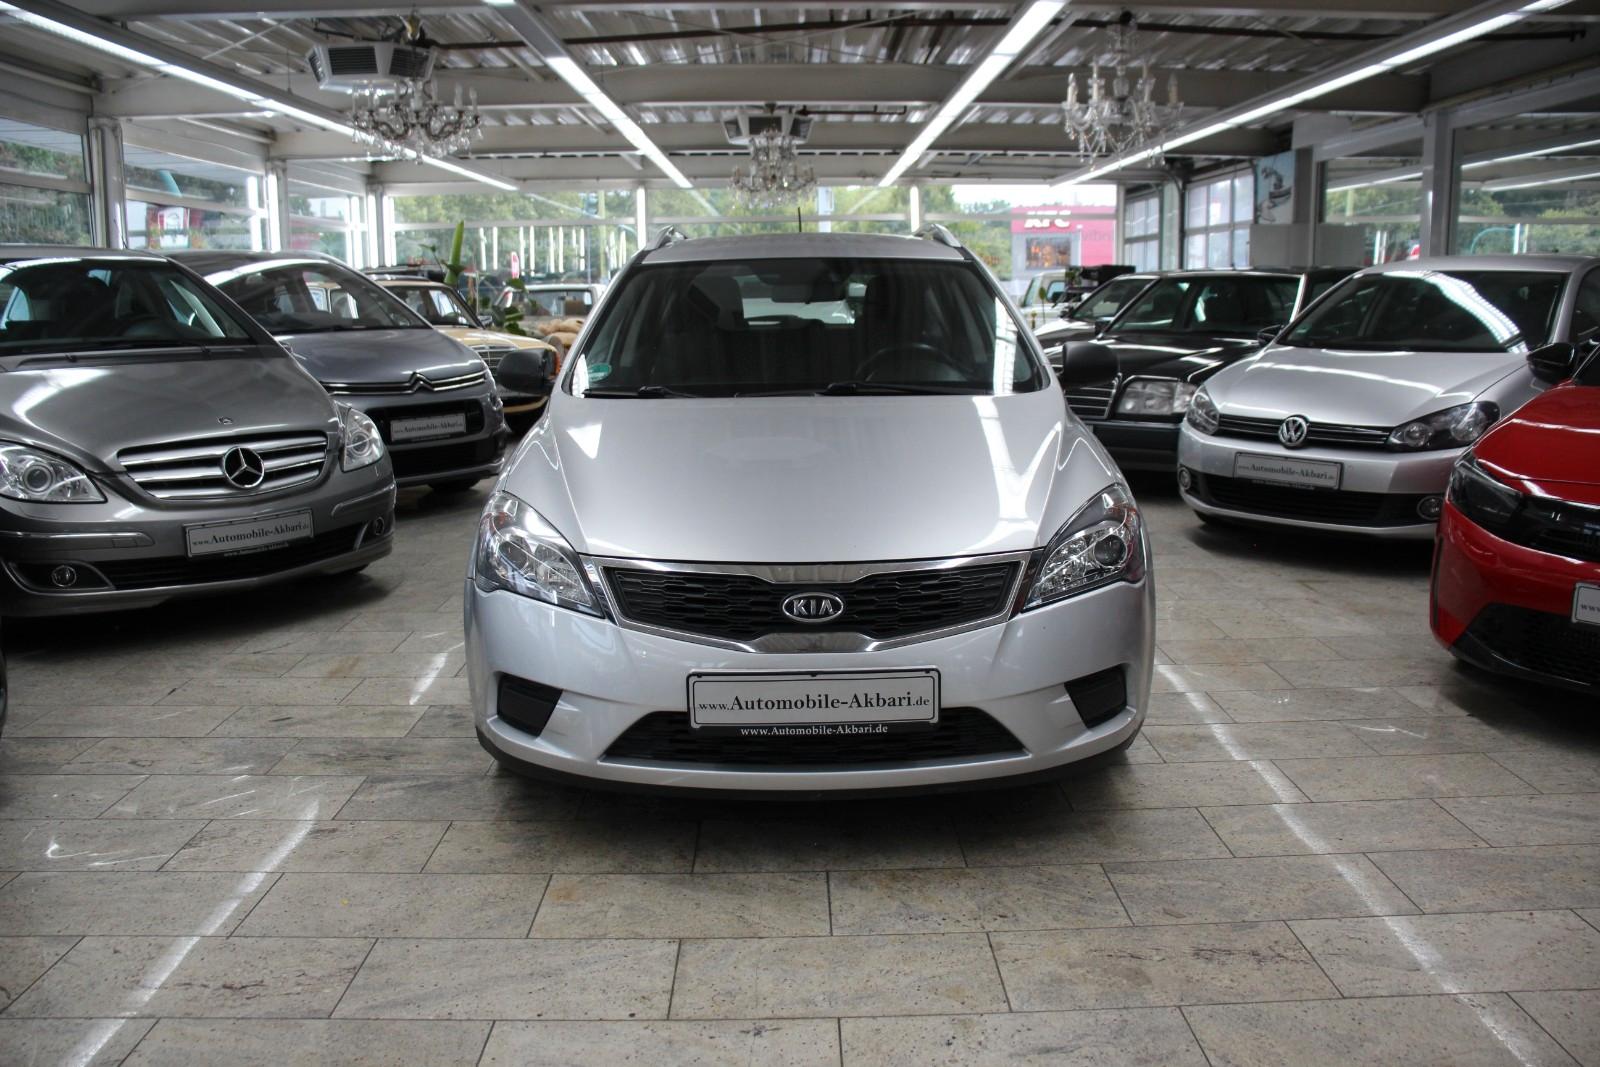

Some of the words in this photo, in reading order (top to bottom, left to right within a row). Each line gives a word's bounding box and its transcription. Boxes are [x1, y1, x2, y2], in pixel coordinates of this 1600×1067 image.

[394, 420, 463, 433] .Automobile-Akbari.
[192, 520, 309, 546] www.Automobile-Akbari.de
[793, 600, 834, 615] KIA
[698, 692, 930, 711] www.Automobile-Akbari.de
[740, 724, 888, 736] www.Automobile-Akbari.de
